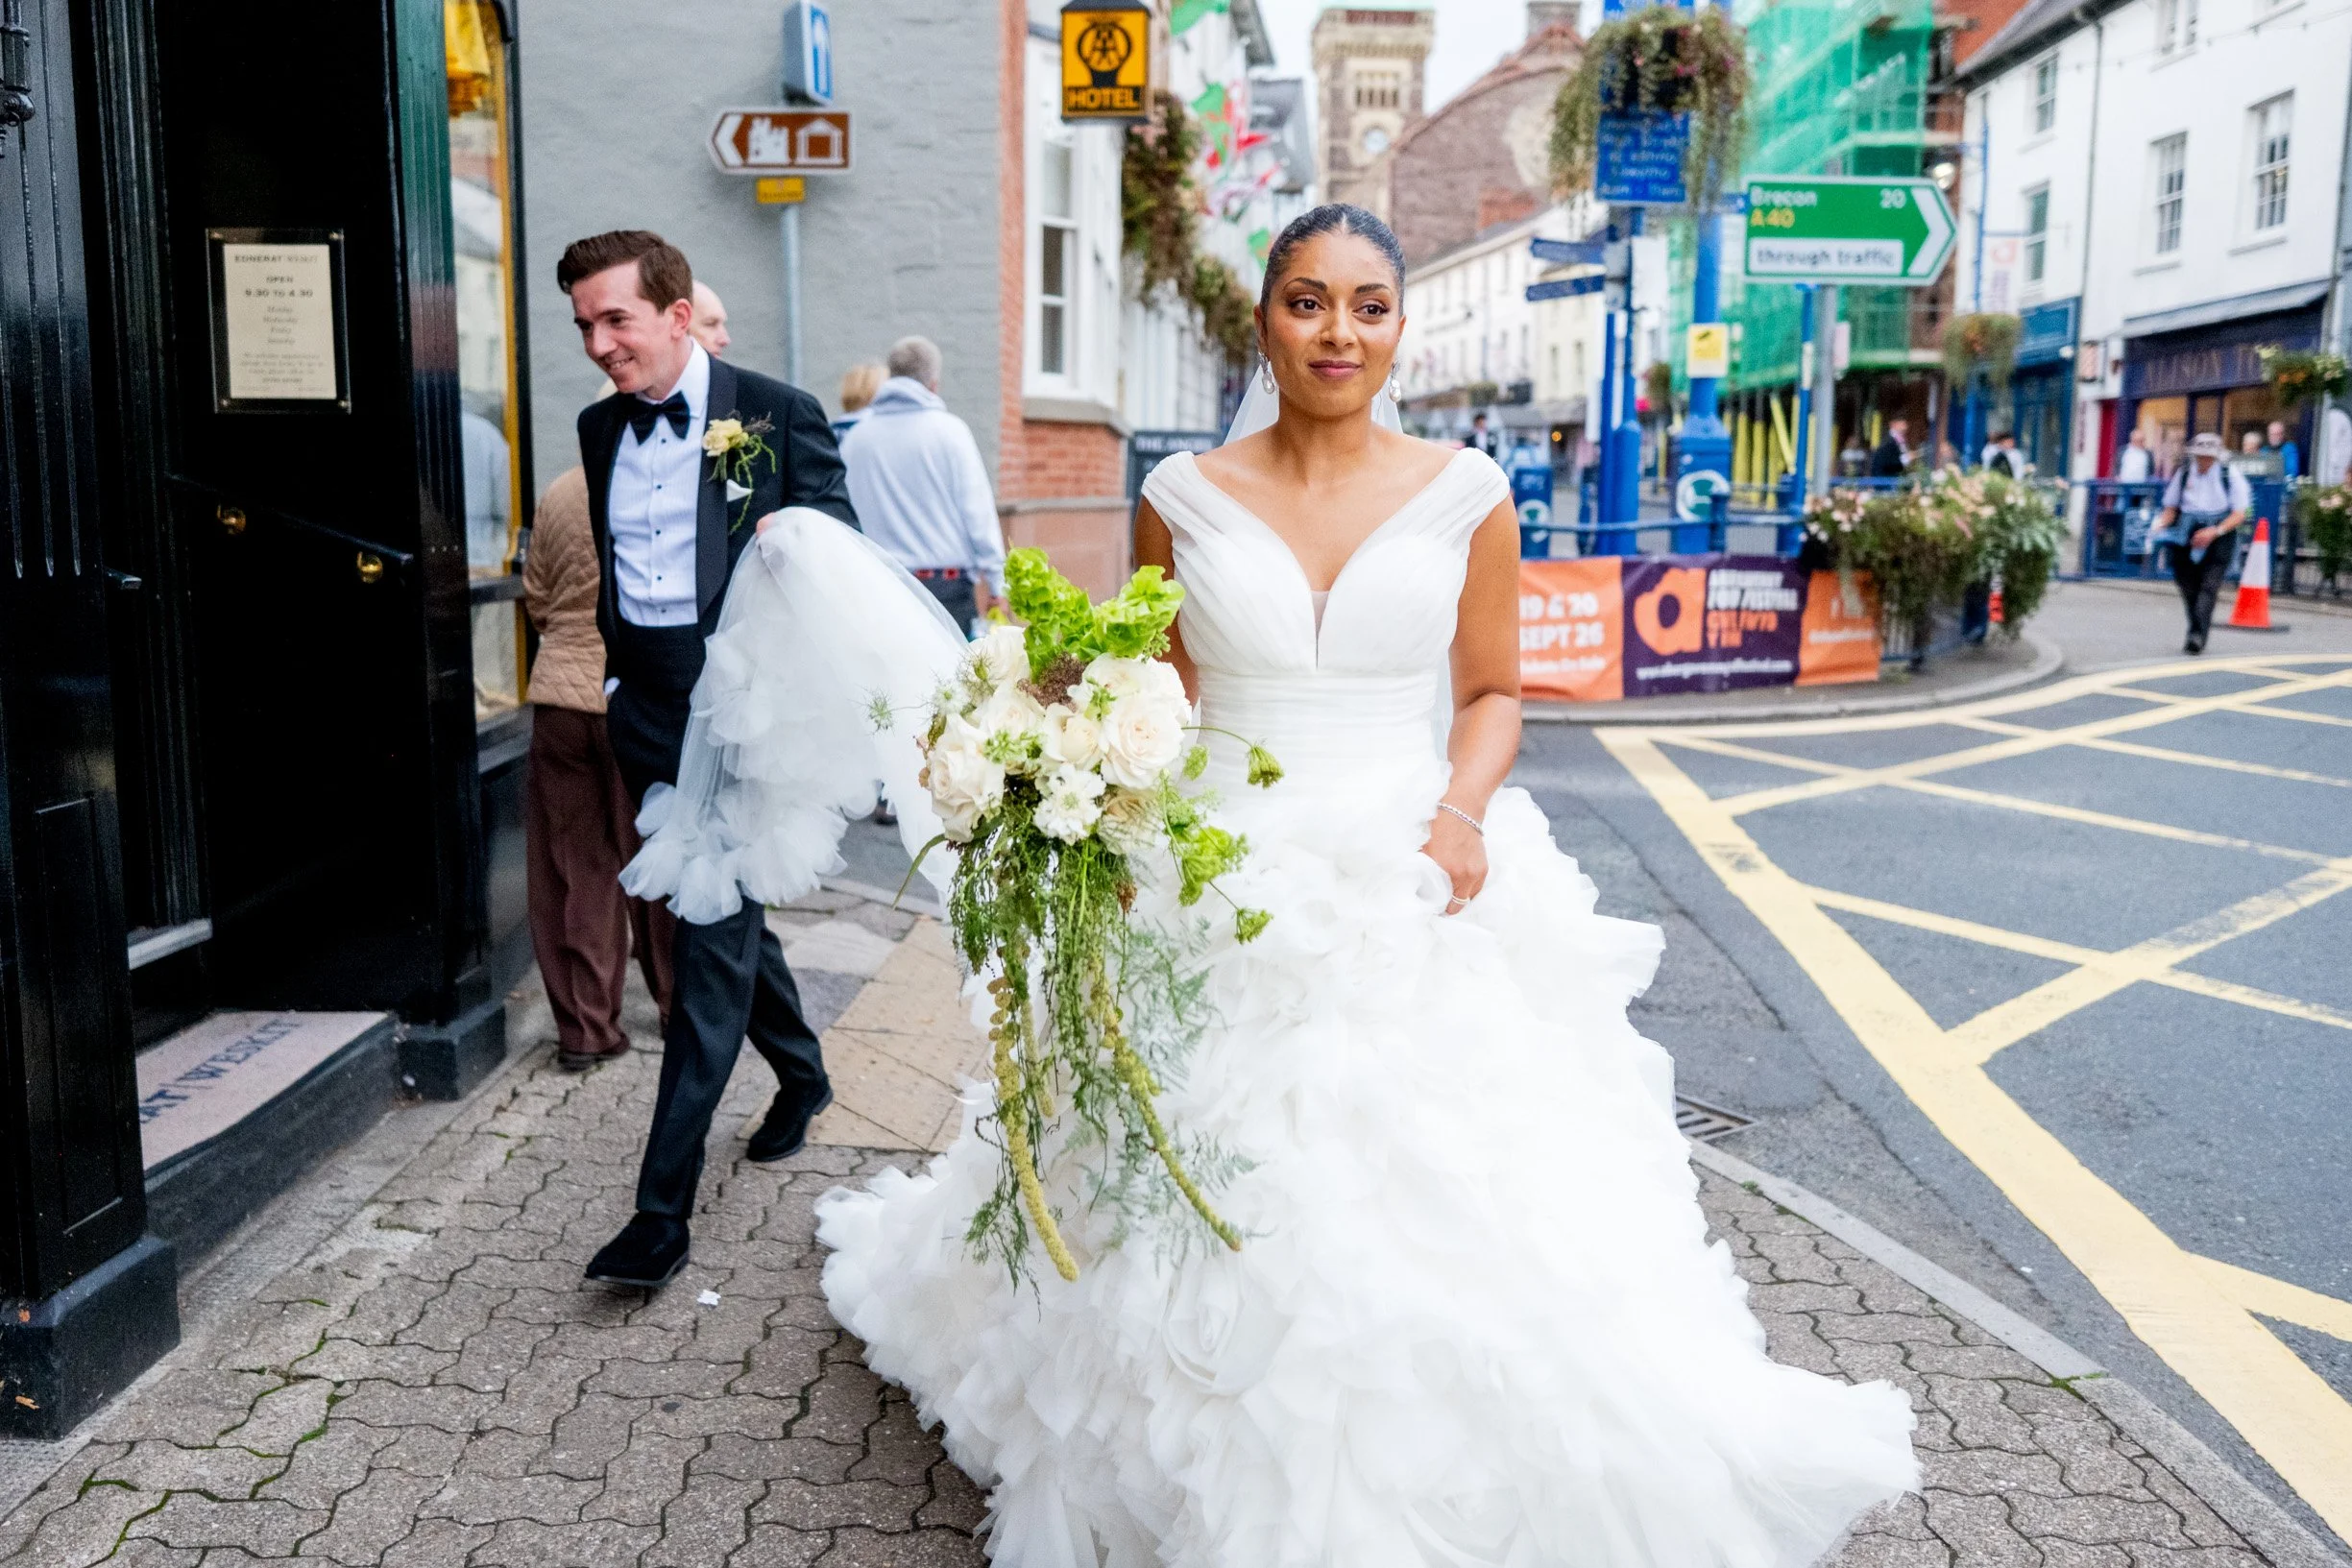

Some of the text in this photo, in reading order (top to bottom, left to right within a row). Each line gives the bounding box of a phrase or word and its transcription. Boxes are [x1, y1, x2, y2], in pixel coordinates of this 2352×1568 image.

[1067, 88, 1140, 109] HOTEL
[1750, 185, 1906, 208] Brecon 20
[1757, 247, 1895, 266] through traffic
